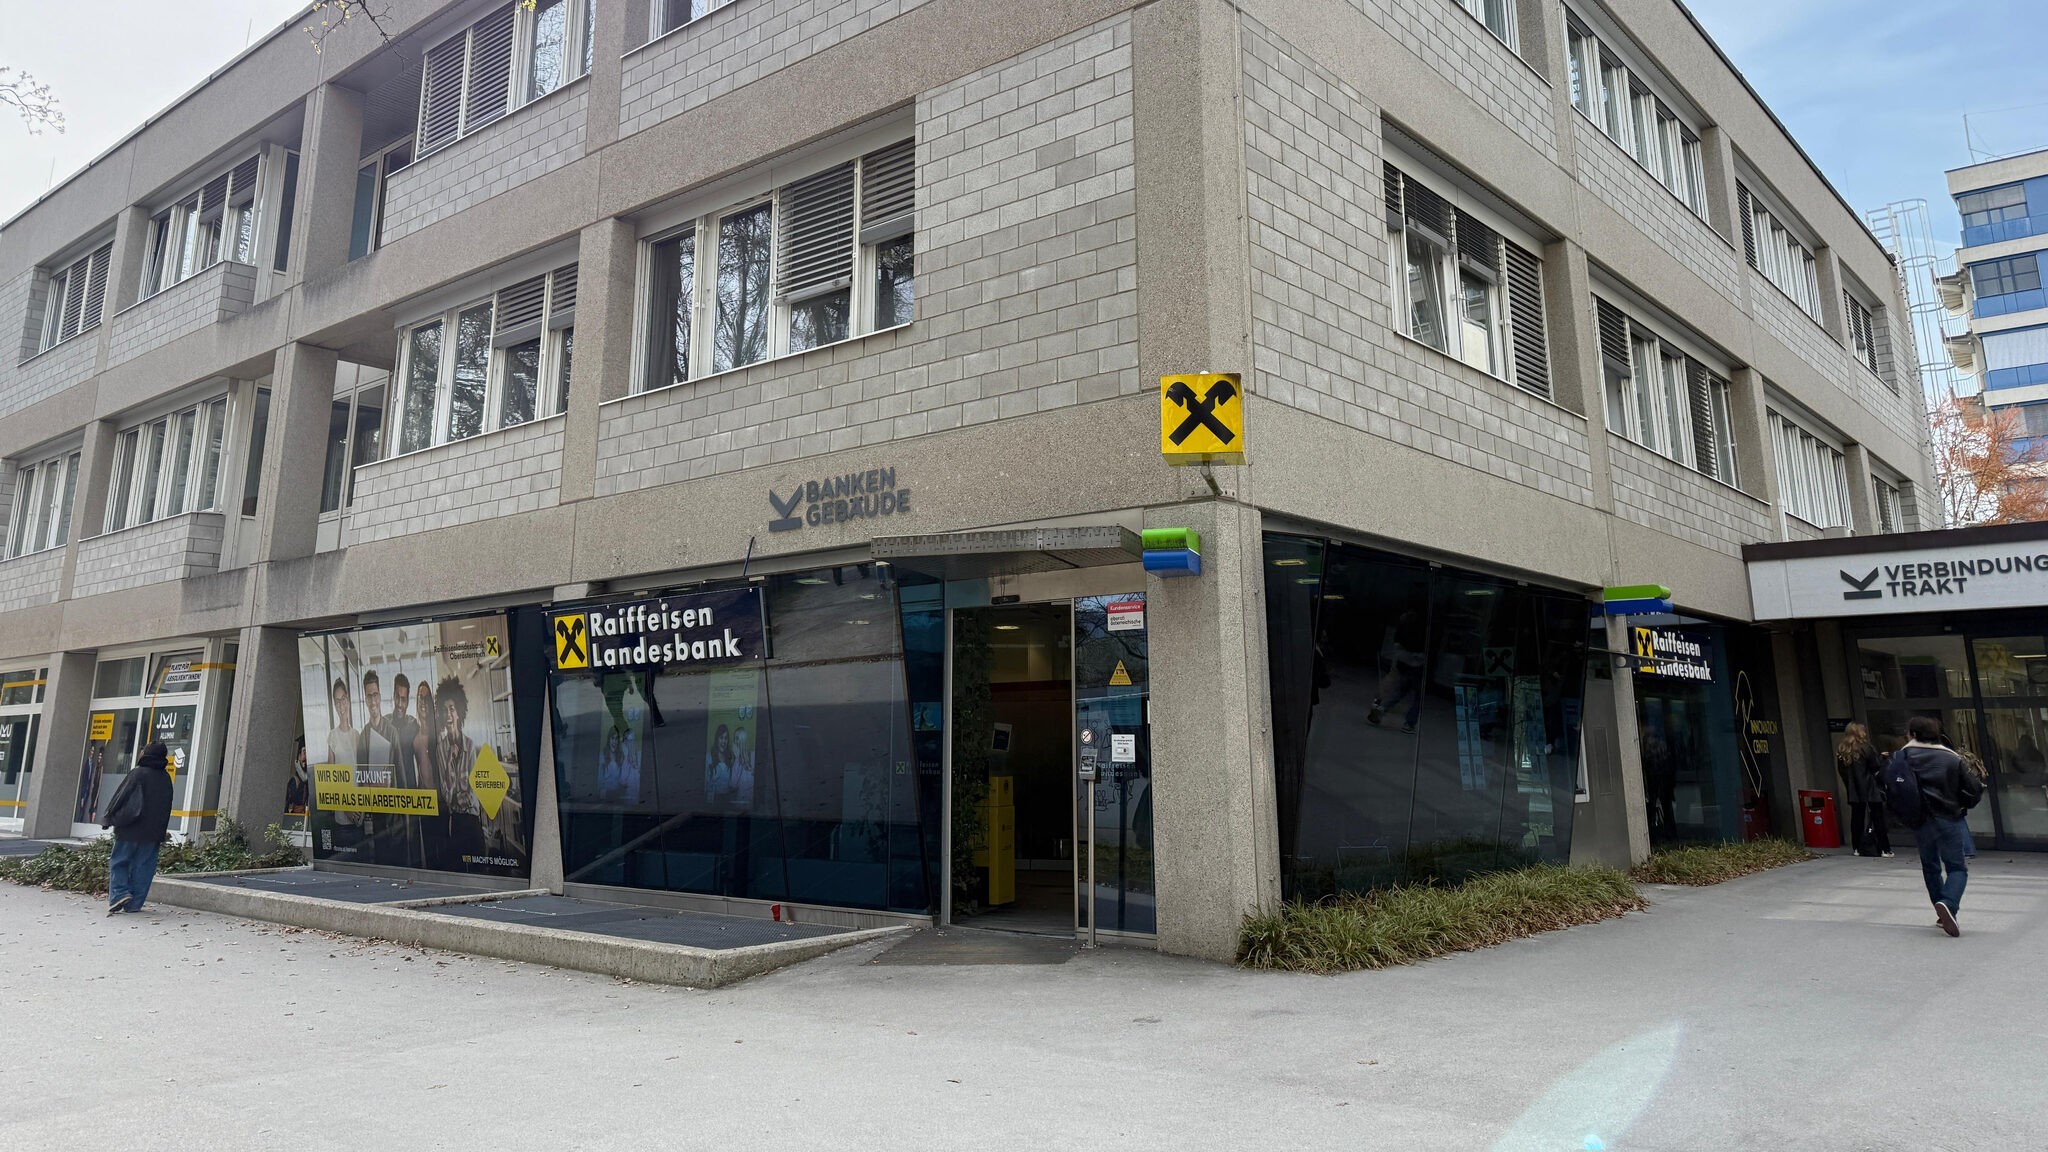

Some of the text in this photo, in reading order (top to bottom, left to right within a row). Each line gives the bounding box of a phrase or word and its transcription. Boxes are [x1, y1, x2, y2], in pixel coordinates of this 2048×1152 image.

[806, 467, 895, 503] BANKEN
[806, 489, 910, 527] GEBÄUDE
[1887, 578, 1967, 597] TRAKT
[590, 603, 713, 637] Raiffeisen
[434, 641, 484, 653] Raiffeisenlandesbank
[592, 628, 742, 667] Landesbank
[1652, 630, 1701, 657] Raiffeisen
[450, 650, 485, 659] Oberösterreich
[1654, 654, 1712, 681] Landesbank
[317, 770, 392, 784] WIR SIND ZUKUNFT
[475, 770, 490, 779] JETZT
[475, 780, 506, 789] BEWERBEN!
[319, 792, 435, 810] MEHR ALS EIN ARBEITSPLATZ.
[462, 855, 471, 863] WIR
